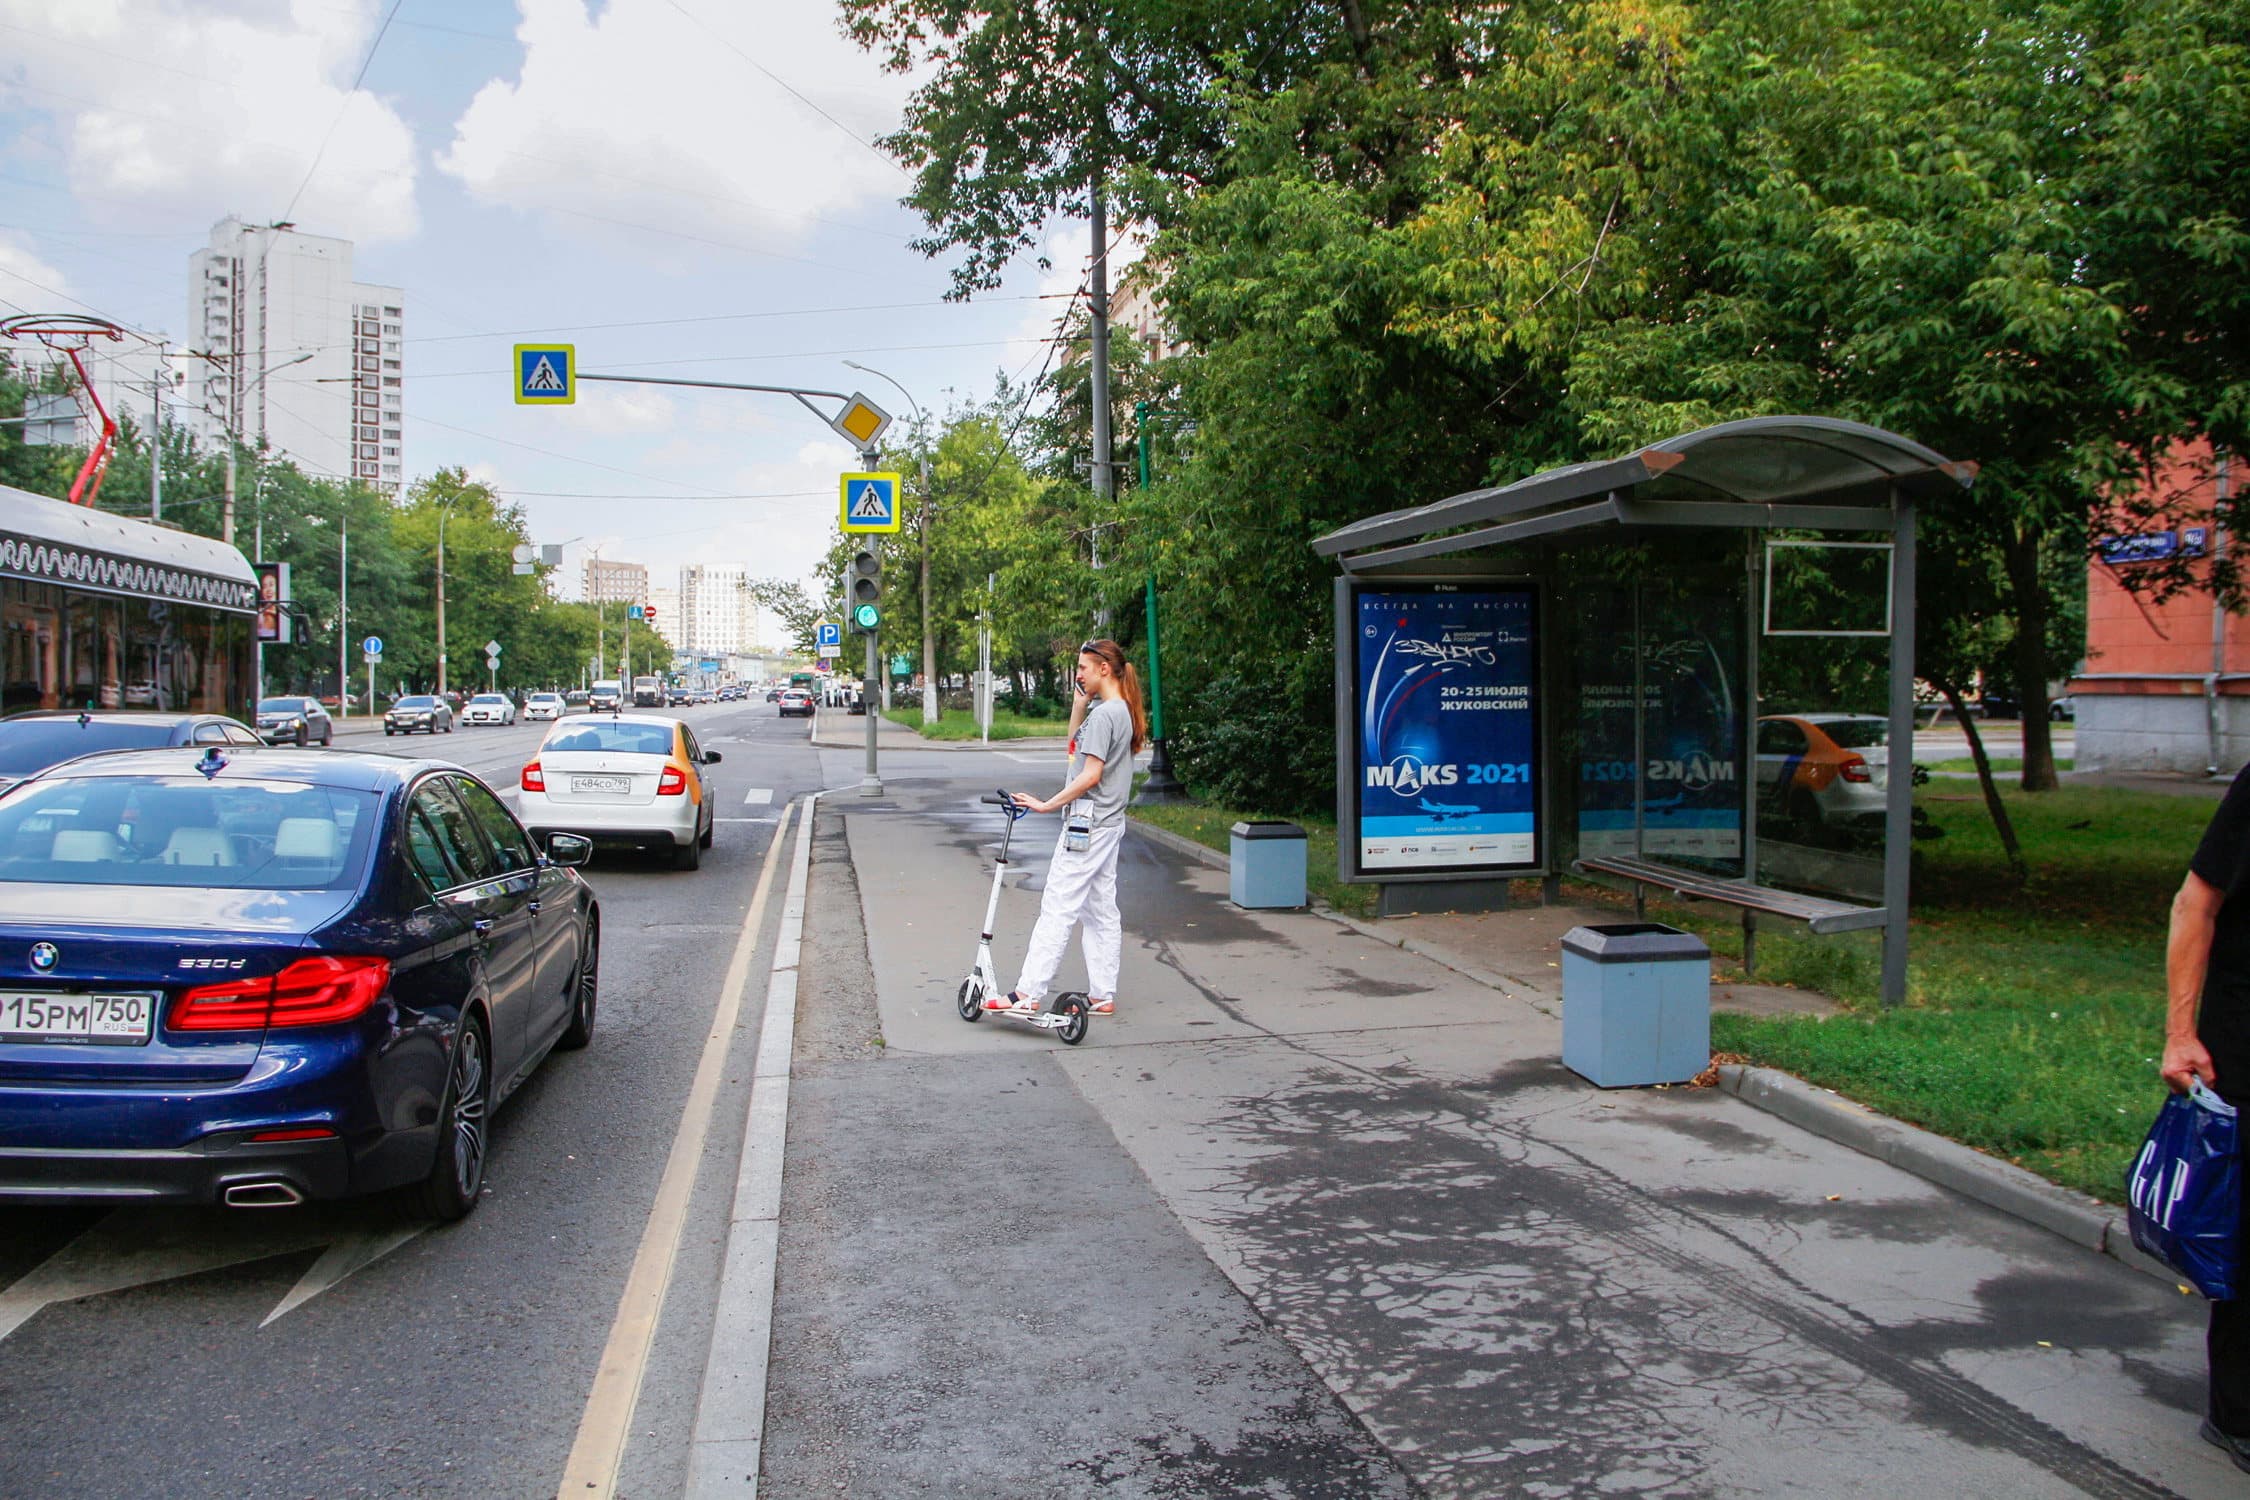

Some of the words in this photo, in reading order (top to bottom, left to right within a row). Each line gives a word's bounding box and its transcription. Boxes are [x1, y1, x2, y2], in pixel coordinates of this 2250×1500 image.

[1364, 602, 1418, 610] ВСЕГДА
[823, 625, 836, 643] P
[1441, 686, 1483, 697] 20-25
[1484, 686, 1528, 696] ИЮЛЯ
[1440, 699, 1528, 711] ЖУКОВСКИЙ
[1366, 758, 1459, 790] MAKS
[1467, 763, 1530, 785] 2021
[178, 959, 247, 969] 530d
[0, 997, 89, 1030] 15РМ
[95, 998, 141, 1022] 750
[103, 1022, 127, 1032] RUS
[2130, 1140, 2190, 1232] GAP
